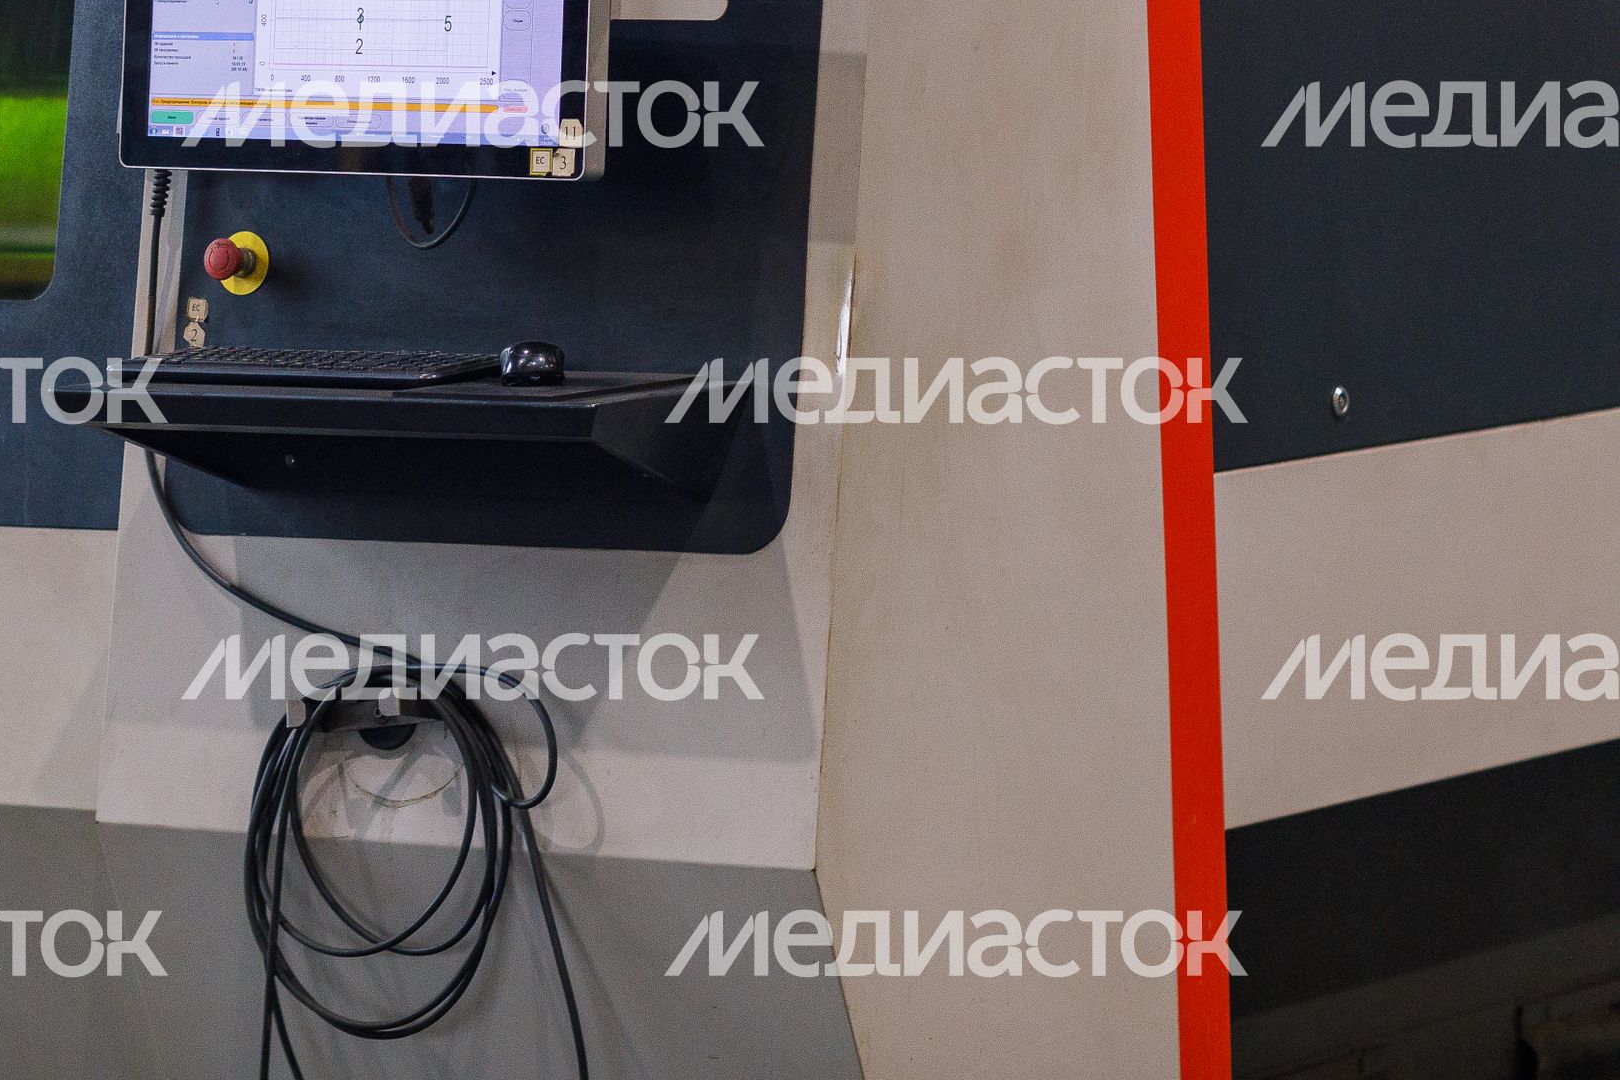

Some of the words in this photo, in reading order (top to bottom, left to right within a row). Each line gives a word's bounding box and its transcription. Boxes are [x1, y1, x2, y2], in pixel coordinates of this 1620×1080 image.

[444, 15, 452, 32] 5
[355, 38, 364, 55] 2
[301, 74, 312, 82] 400
[367, 75, 381, 83] 1200
[402, 76, 416, 84] 1600
[436, 76, 450, 85] 2000
[480, 77, 494, 86] 2500
[565, 126, 576, 140] 11
[535, 156, 545, 165] EC
[559, 156, 567, 170] 3
[191, 328, 198, 341] 2
